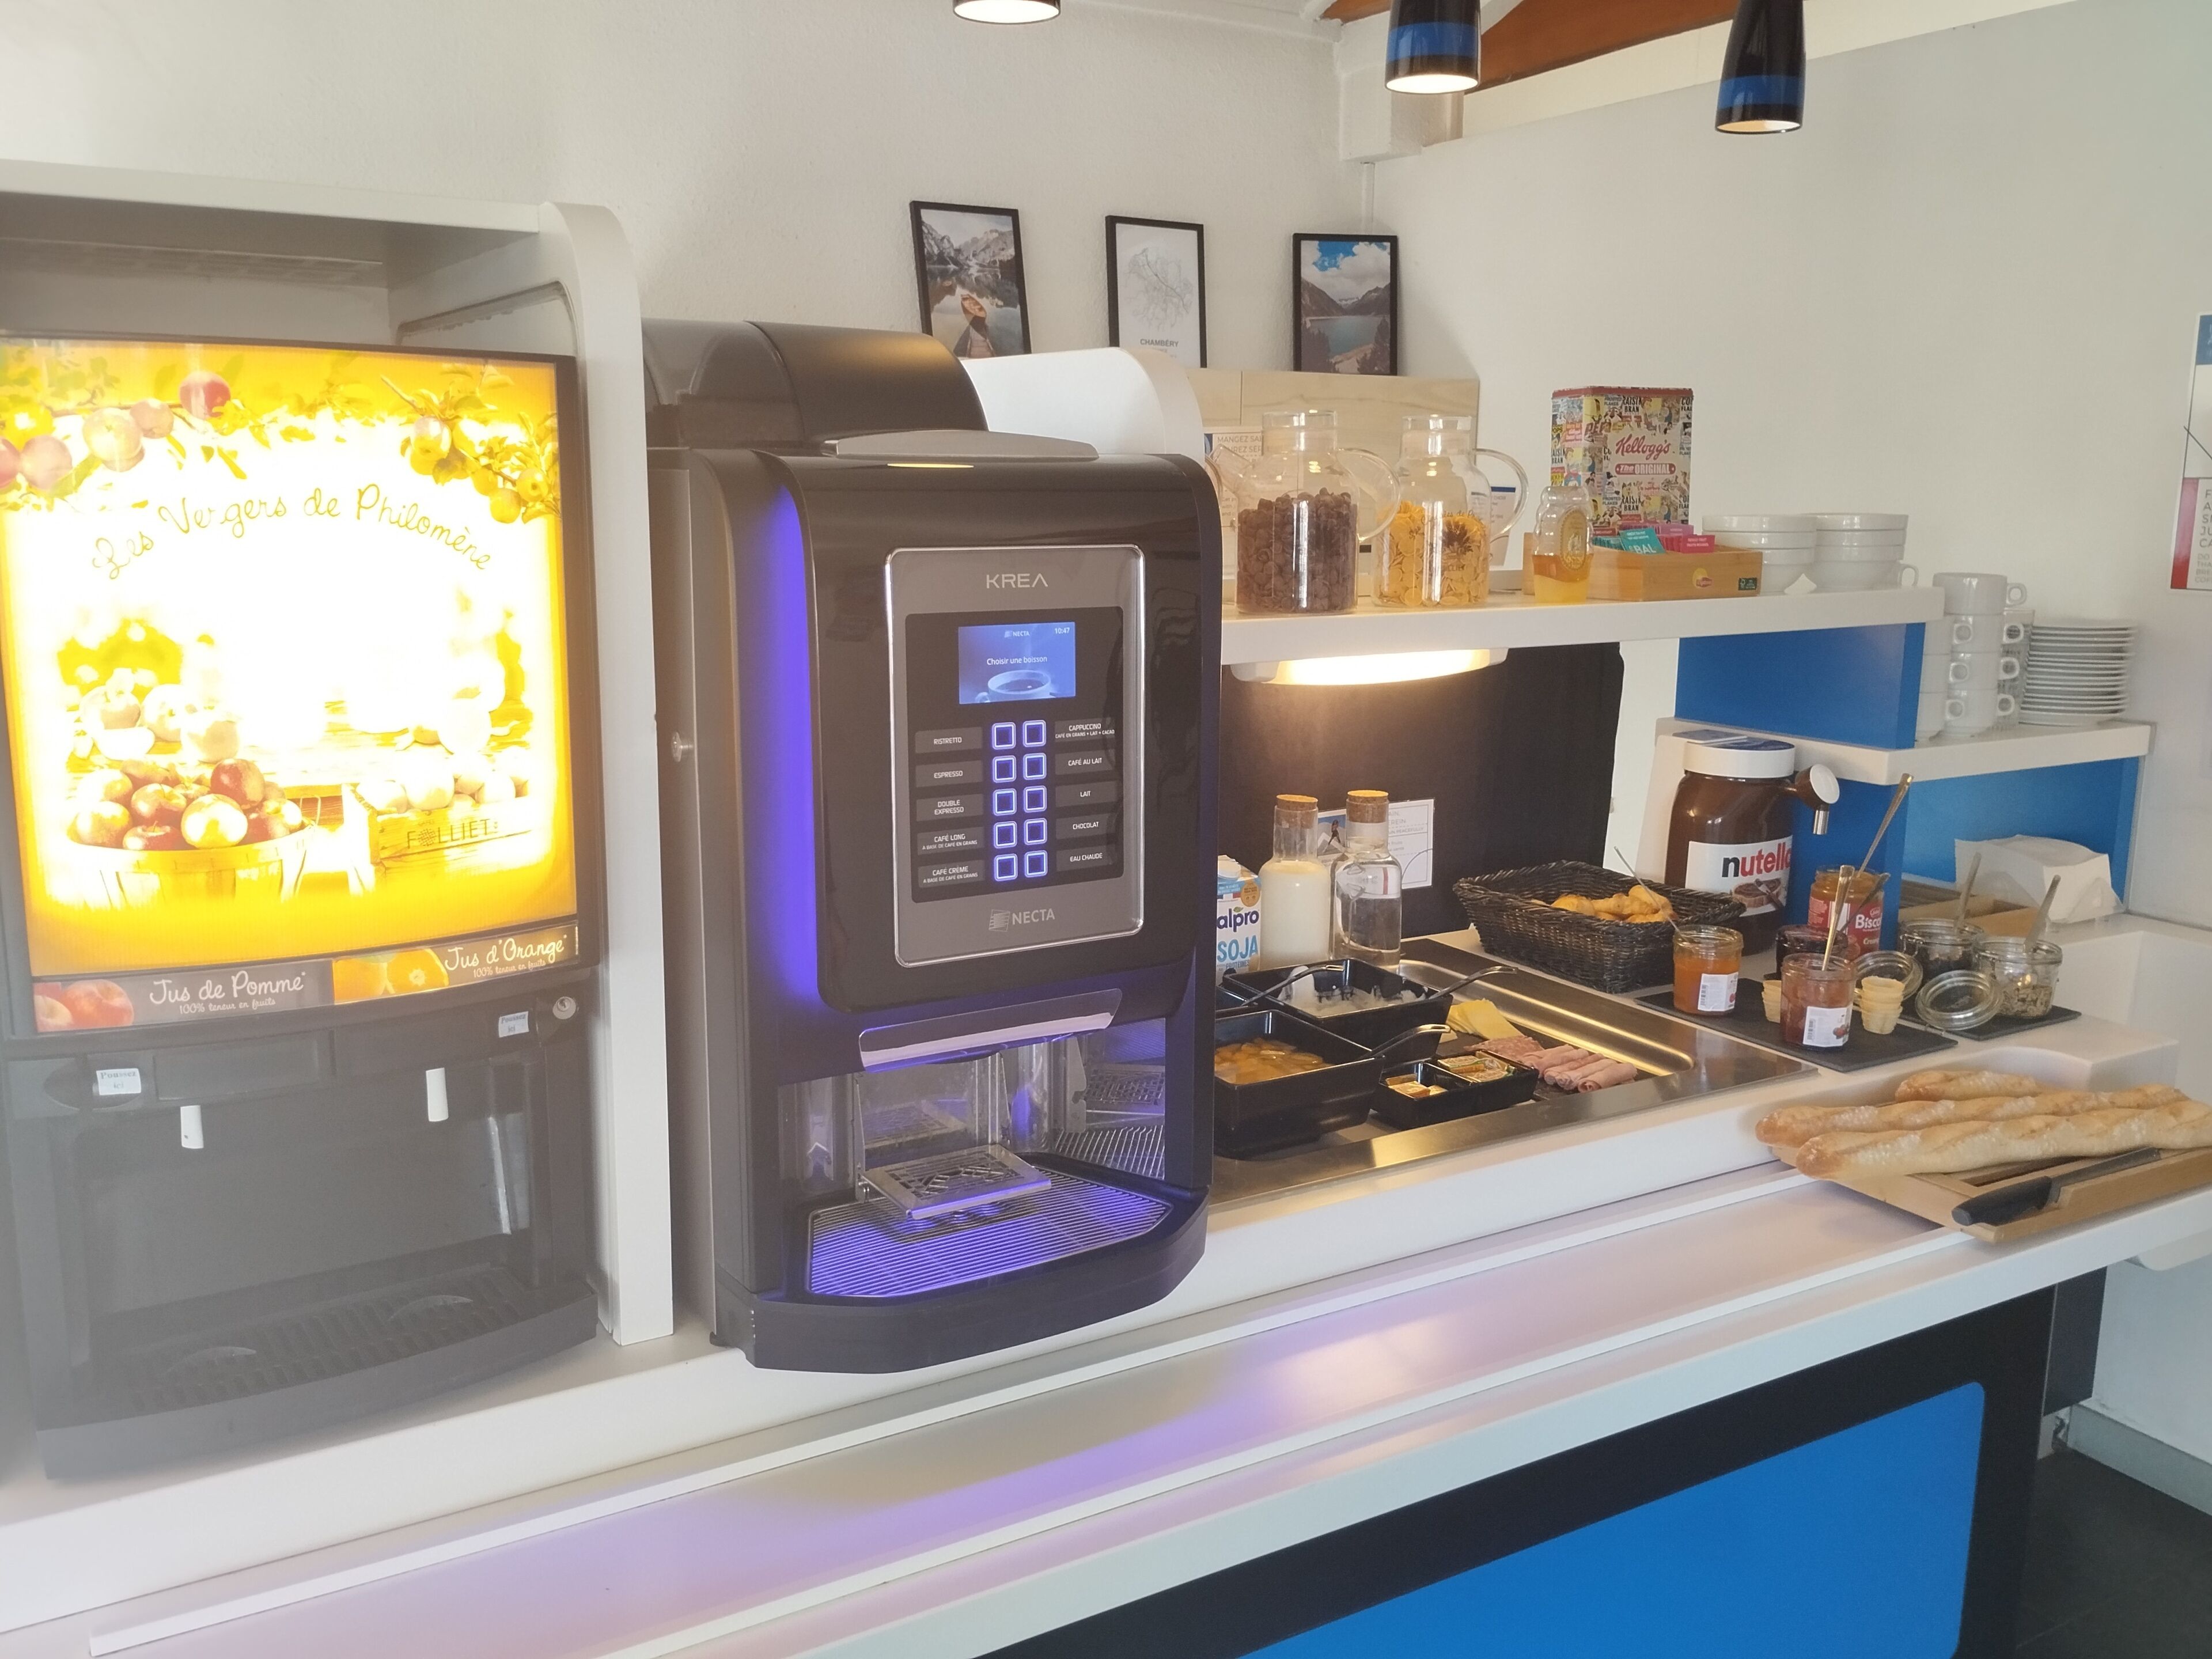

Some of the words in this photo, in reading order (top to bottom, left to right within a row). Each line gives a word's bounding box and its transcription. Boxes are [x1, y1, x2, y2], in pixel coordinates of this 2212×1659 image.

[1140, 339, 1179, 347] CHAMBÉRY
[1616, 433, 1671, 461] Kellogg's
[1635, 464, 1671, 475] ORIGINAL
[92, 531, 154, 579] Les
[158, 497, 287, 538] Vergers
[304, 487, 340, 517] de
[357, 484, 491, 570] Philomène
[986, 573, 1048, 589] KREA
[987, 657, 1009, 665] Choisir
[1069, 723, 1101, 731] CAPPUCCINO
[934, 737, 962, 745] RISTRETTO
[1068, 758, 1082, 766] CAFÉ
[934, 770, 963, 779] ESPRESSO
[937, 800, 960, 808] DOUBLE
[934, 806, 964, 815] EXPRESSO
[1073, 821, 1099, 830] CHOCOLAT
[934, 833, 949, 842] CAFÉ
[1082, 853, 1103, 861] CHAUDE
[933, 867, 947, 876] CAFÉ
[949, 865, 969, 874] CRÈME
[1012, 908, 1055, 925] NECTA
[1217, 908, 1259, 932] alpro
[1217, 935, 1259, 963] SOJA
[444, 946, 479, 971] Jus
[473, 967, 493, 978] 100%
[495, 964, 517, 974] teneur
[528, 958, 546, 970] fruits
[150, 979, 191, 1004] Jus
[198, 979, 225, 1000] de
[179, 1002, 205, 1014] 100%
[209, 1002, 236, 1012] teneur
[252, 997, 276, 1010] fruits
[502, 1013, 526, 1024] Poussez
[100, 1071, 136, 1080] Poussez
